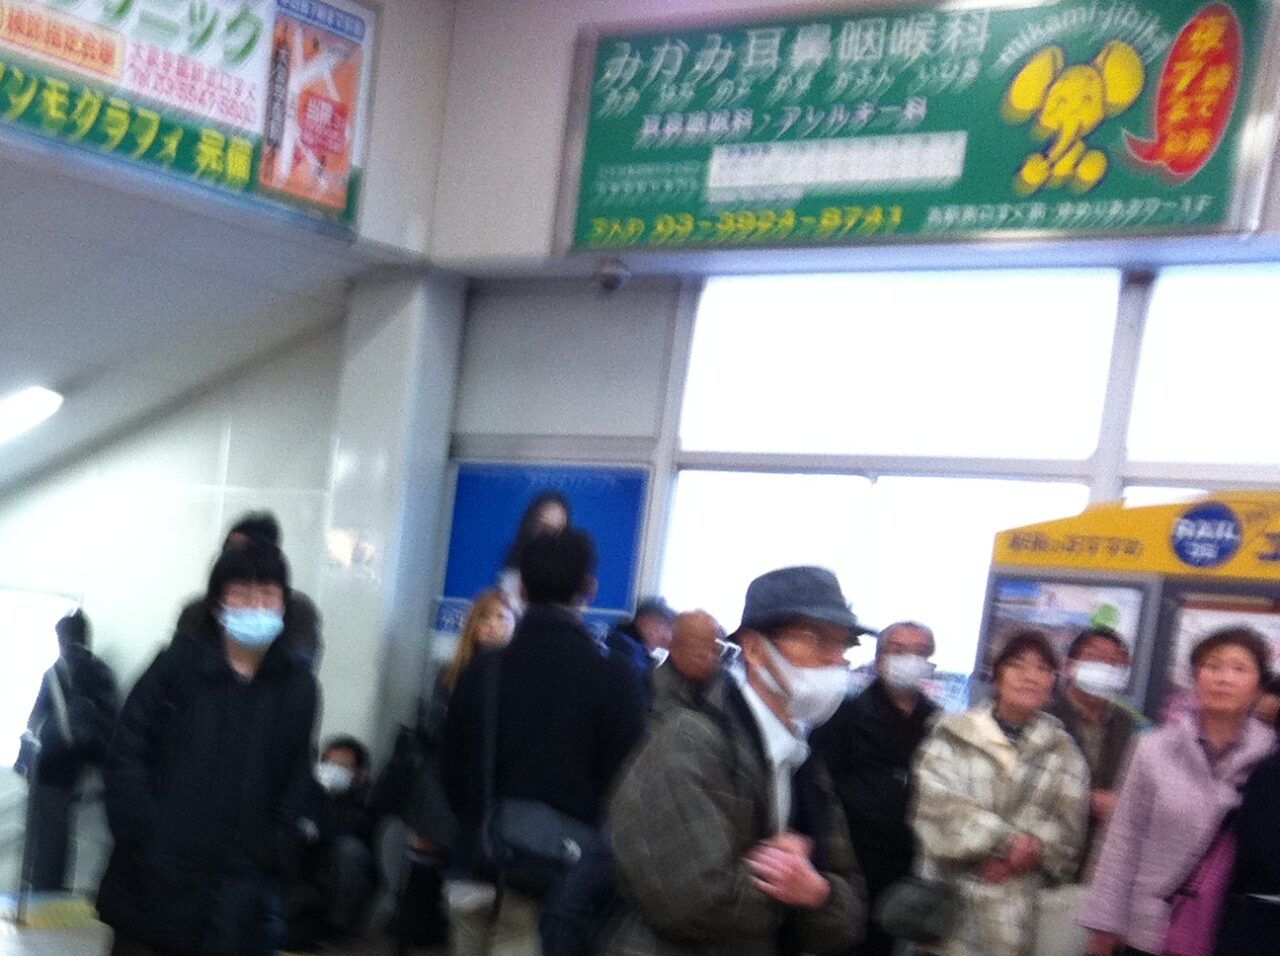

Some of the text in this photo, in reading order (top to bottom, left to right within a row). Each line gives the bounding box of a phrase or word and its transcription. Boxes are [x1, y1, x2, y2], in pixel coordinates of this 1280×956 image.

[600, 11, 988, 85] みかみ耳鼻咽喉科
